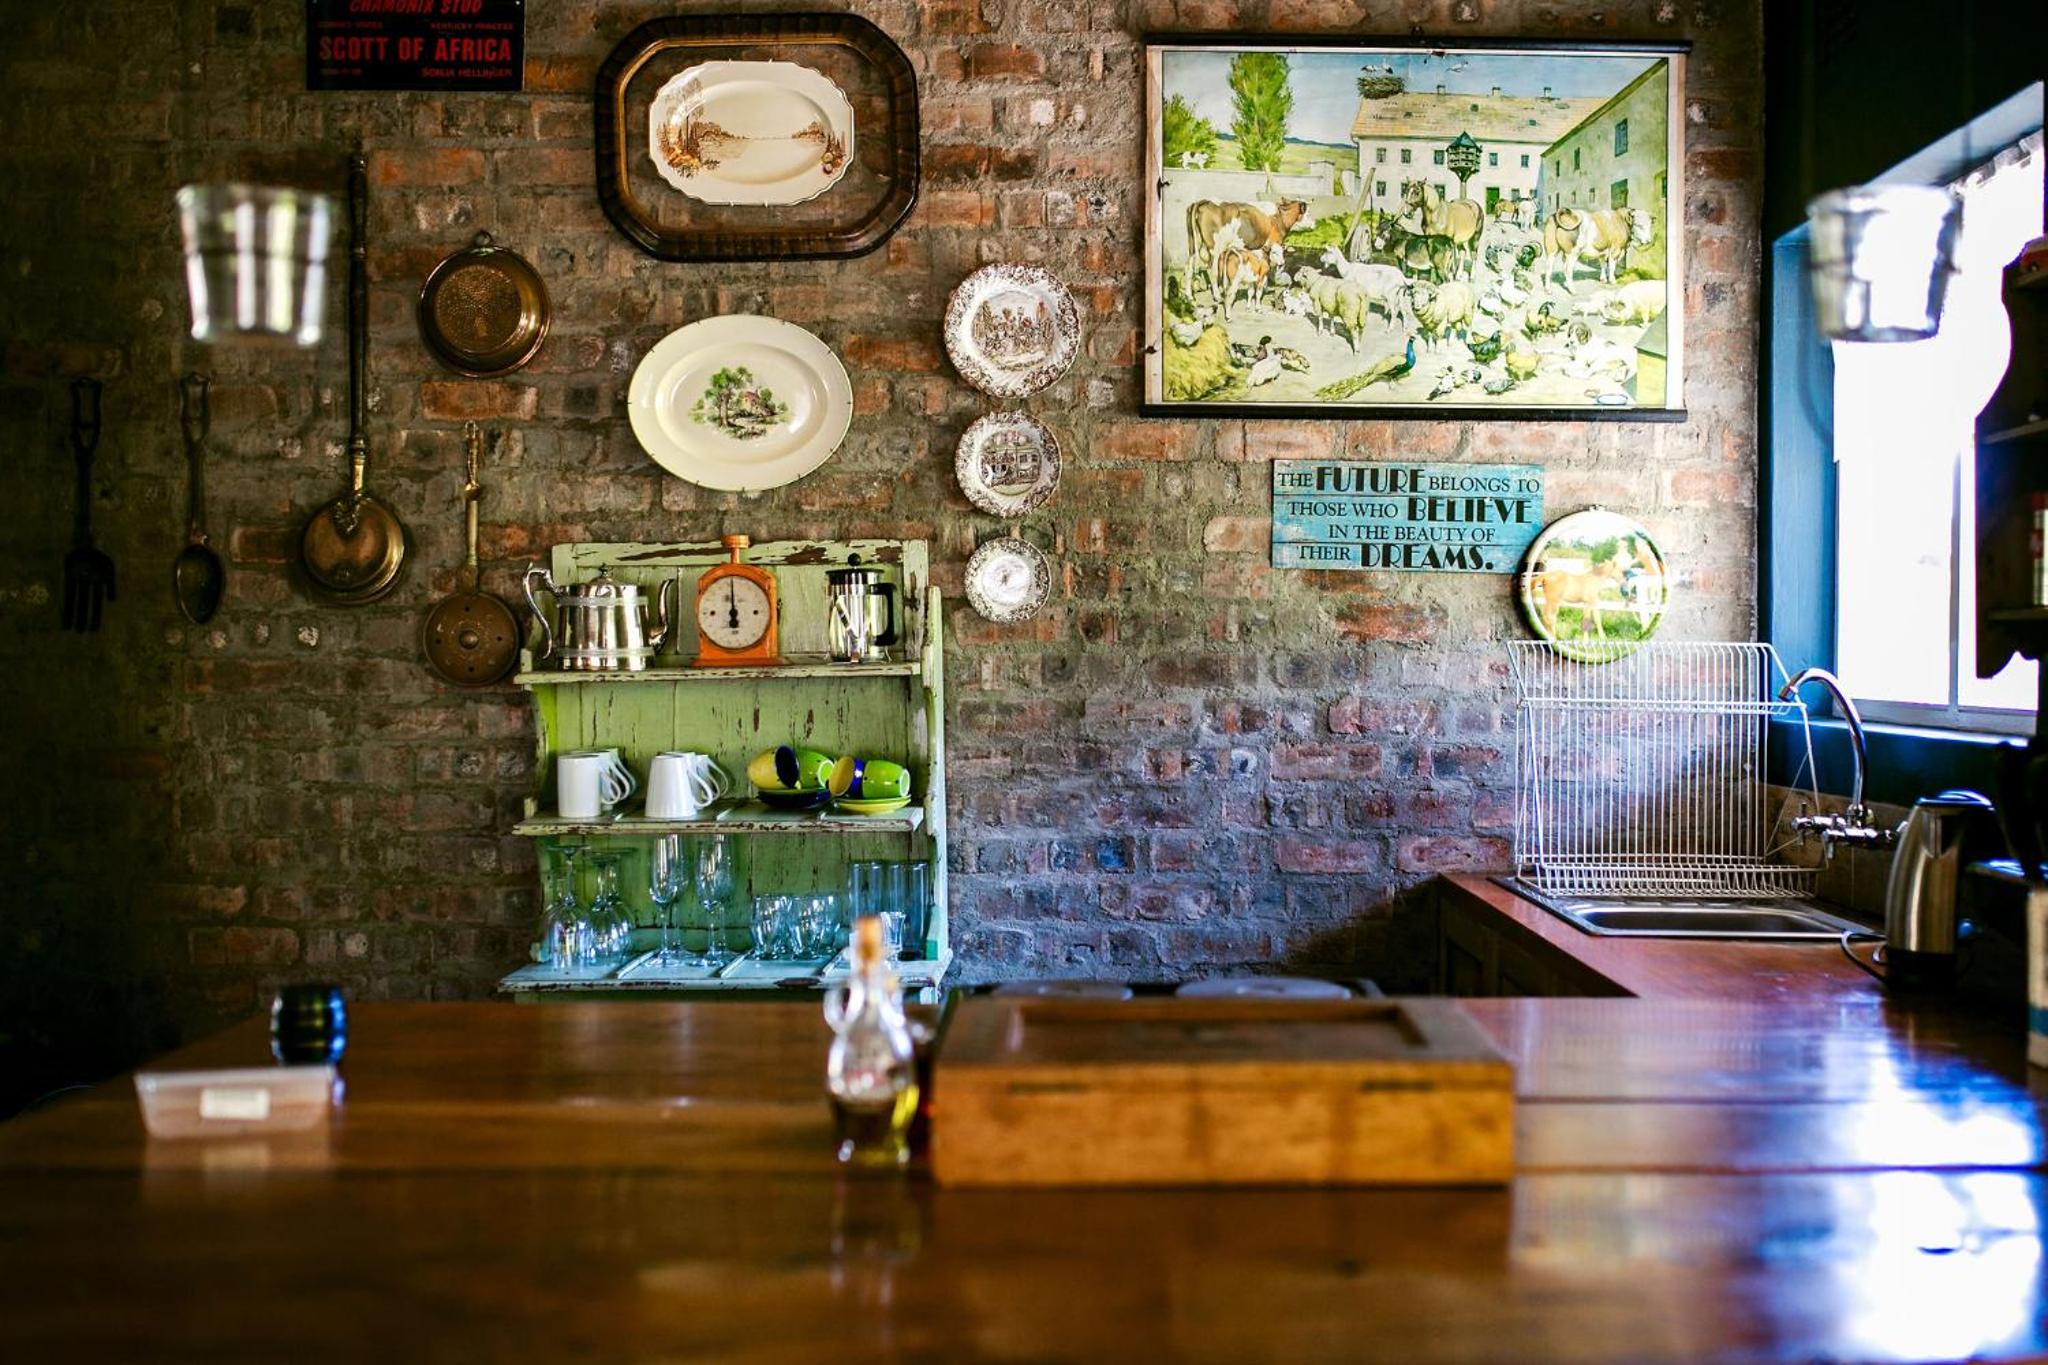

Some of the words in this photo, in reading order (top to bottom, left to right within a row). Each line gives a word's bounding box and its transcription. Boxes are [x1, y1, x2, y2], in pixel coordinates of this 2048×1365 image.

[318, 36, 389, 61] SCOTT
[398, 37, 424, 61] OF
[434, 37, 512, 62] AFRICA
[1278, 473, 1313, 487] THE
[1316, 466, 1426, 494] FUTURE
[1428, 476, 1511, 493] BELONGS
[1517, 479, 1541, 494] TO
[1287, 501, 1348, 517] THOSE
[1352, 503, 1399, 519] WHO
[1407, 496, 1533, 525] BELIEVE
[1328, 524, 1349, 539] IN
[1352, 525, 1390, 540] THE
[1394, 526, 1467, 541] BEAUTY
[1471, 528, 1496, 543] OF
[1297, 545, 1351, 561] THEIR
[1361, 543, 1494, 570] DREAMS.
